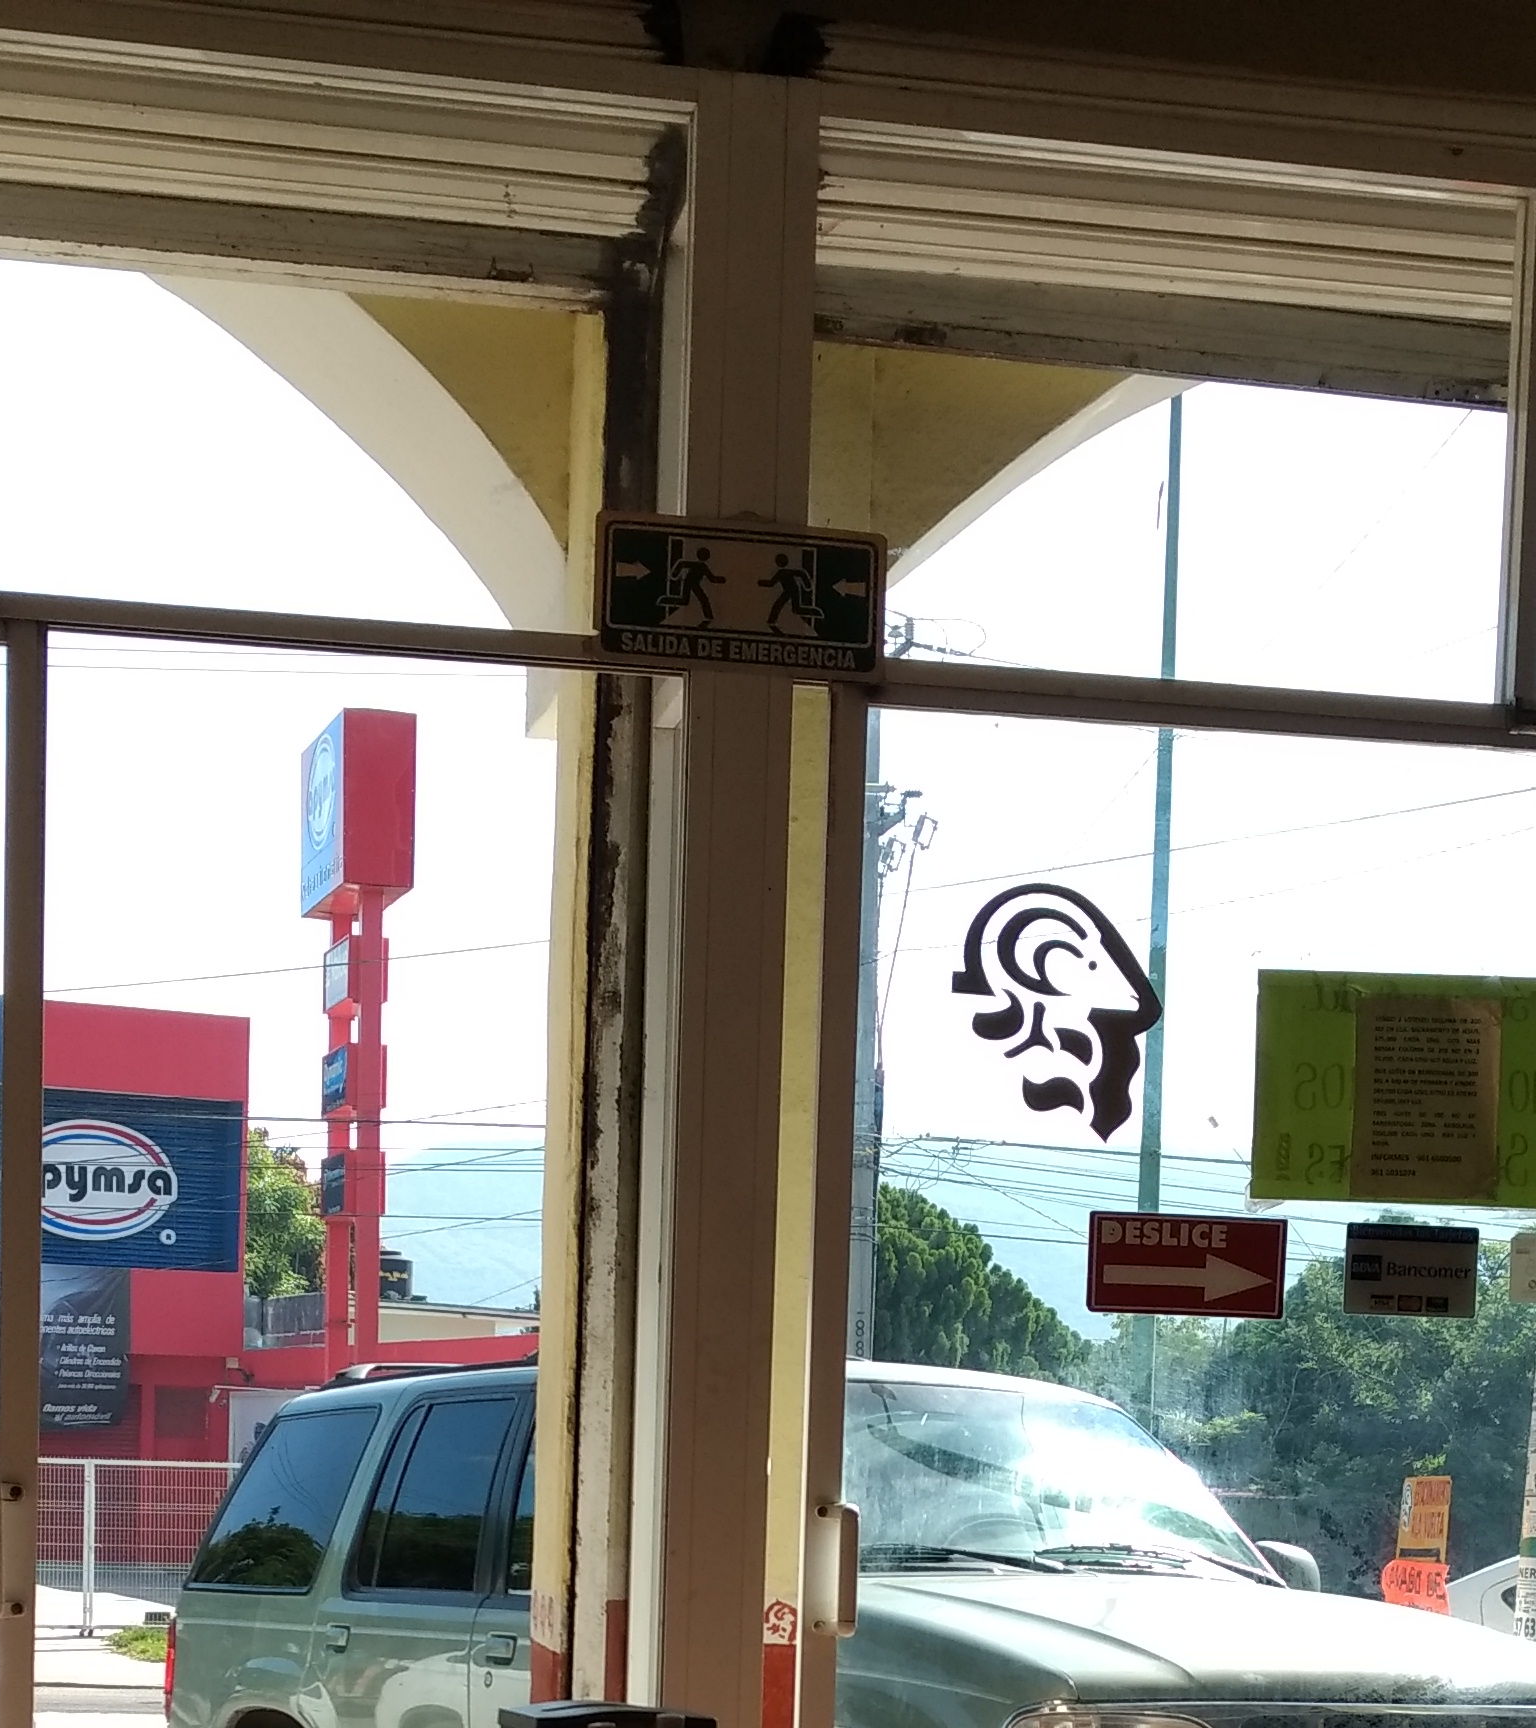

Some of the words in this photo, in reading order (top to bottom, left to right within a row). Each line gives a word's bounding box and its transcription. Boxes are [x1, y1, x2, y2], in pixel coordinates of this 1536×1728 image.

[621, 632, 691, 656] SALIDA
[697, 638, 724, 659] DE
[729, 640, 856, 670] EMERGENCIA
[42, 1163, 173, 1203] pymsa
[1100, 1220, 1228, 1248] DESLICE
[1386, 1261, 1472, 1279] Bancomer
